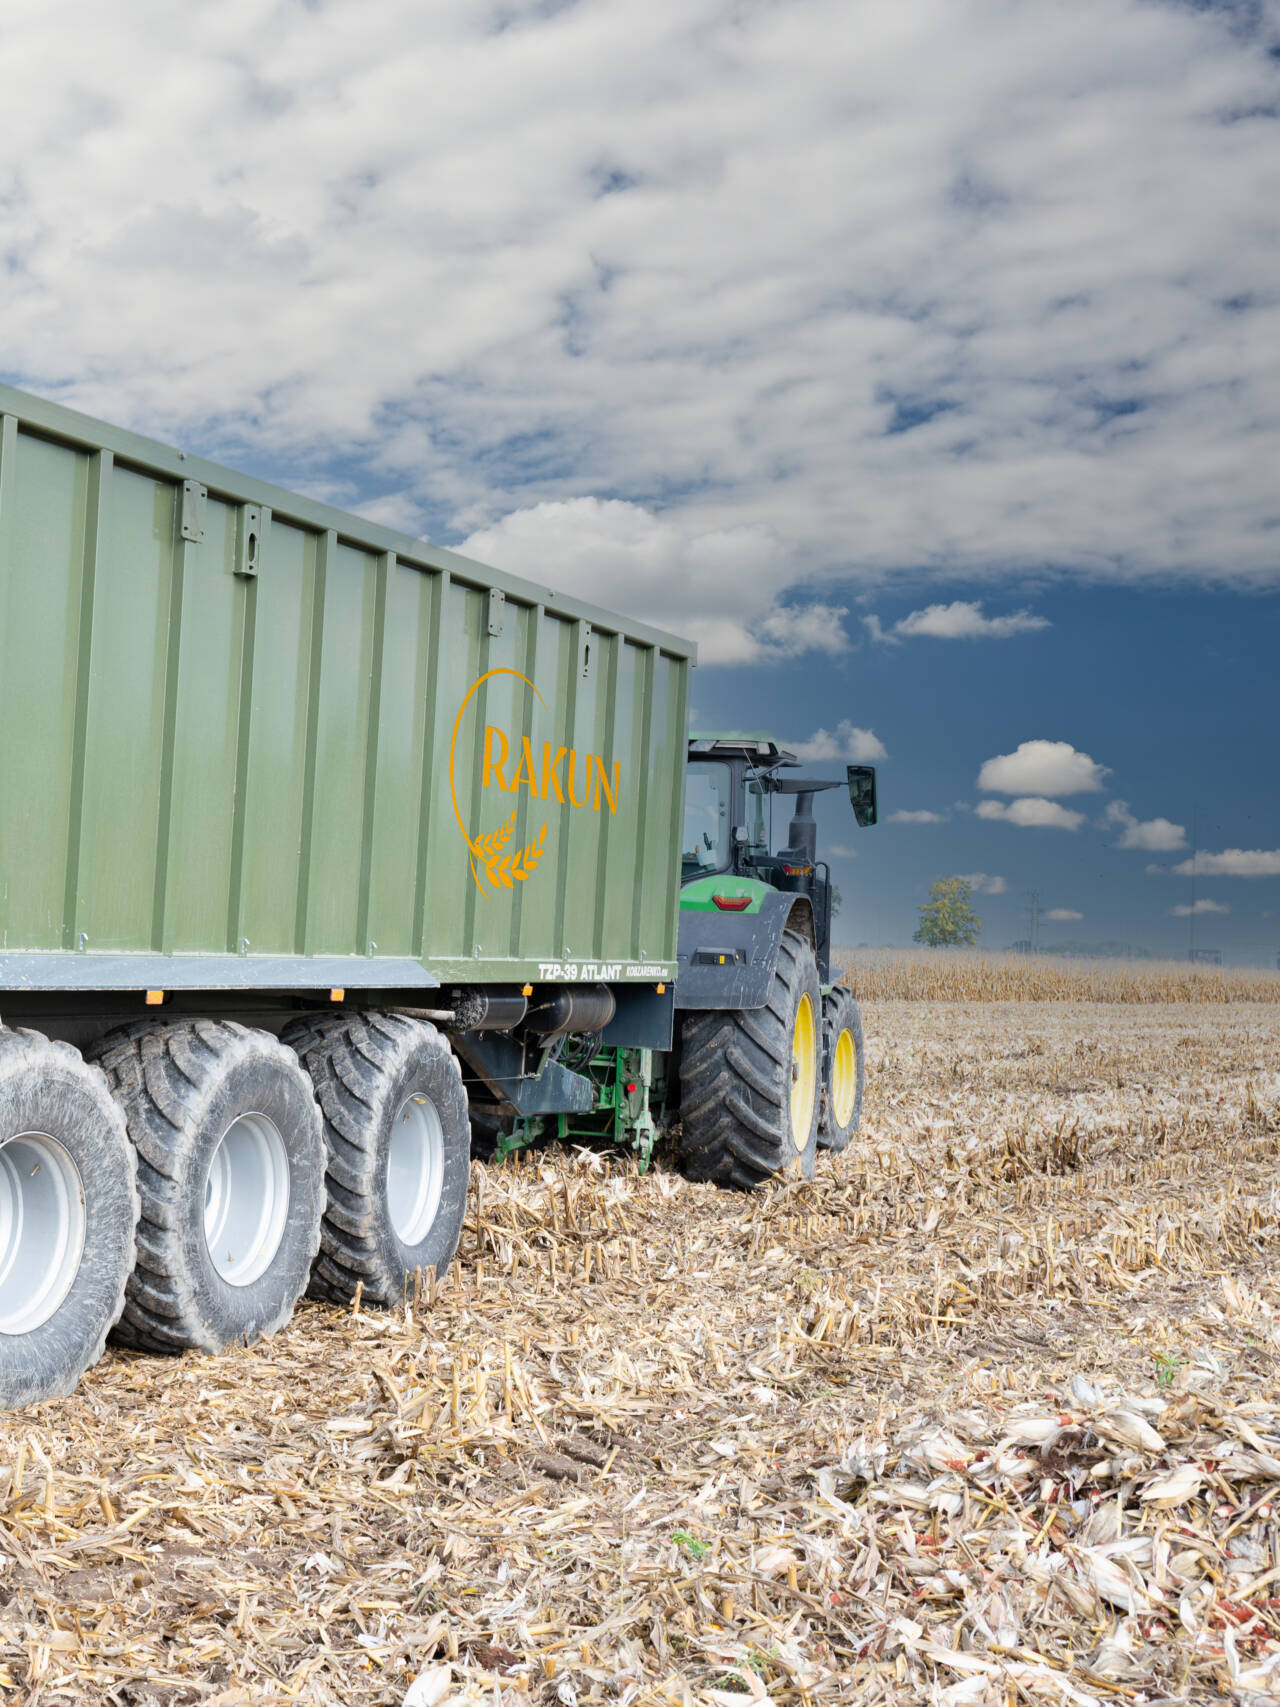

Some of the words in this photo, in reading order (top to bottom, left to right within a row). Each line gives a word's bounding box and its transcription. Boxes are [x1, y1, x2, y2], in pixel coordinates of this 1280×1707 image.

[481, 725, 621, 815] RAKUN
[538, 963, 578, 980] TZP-39
[580, 964, 622, 980] ATLANT
